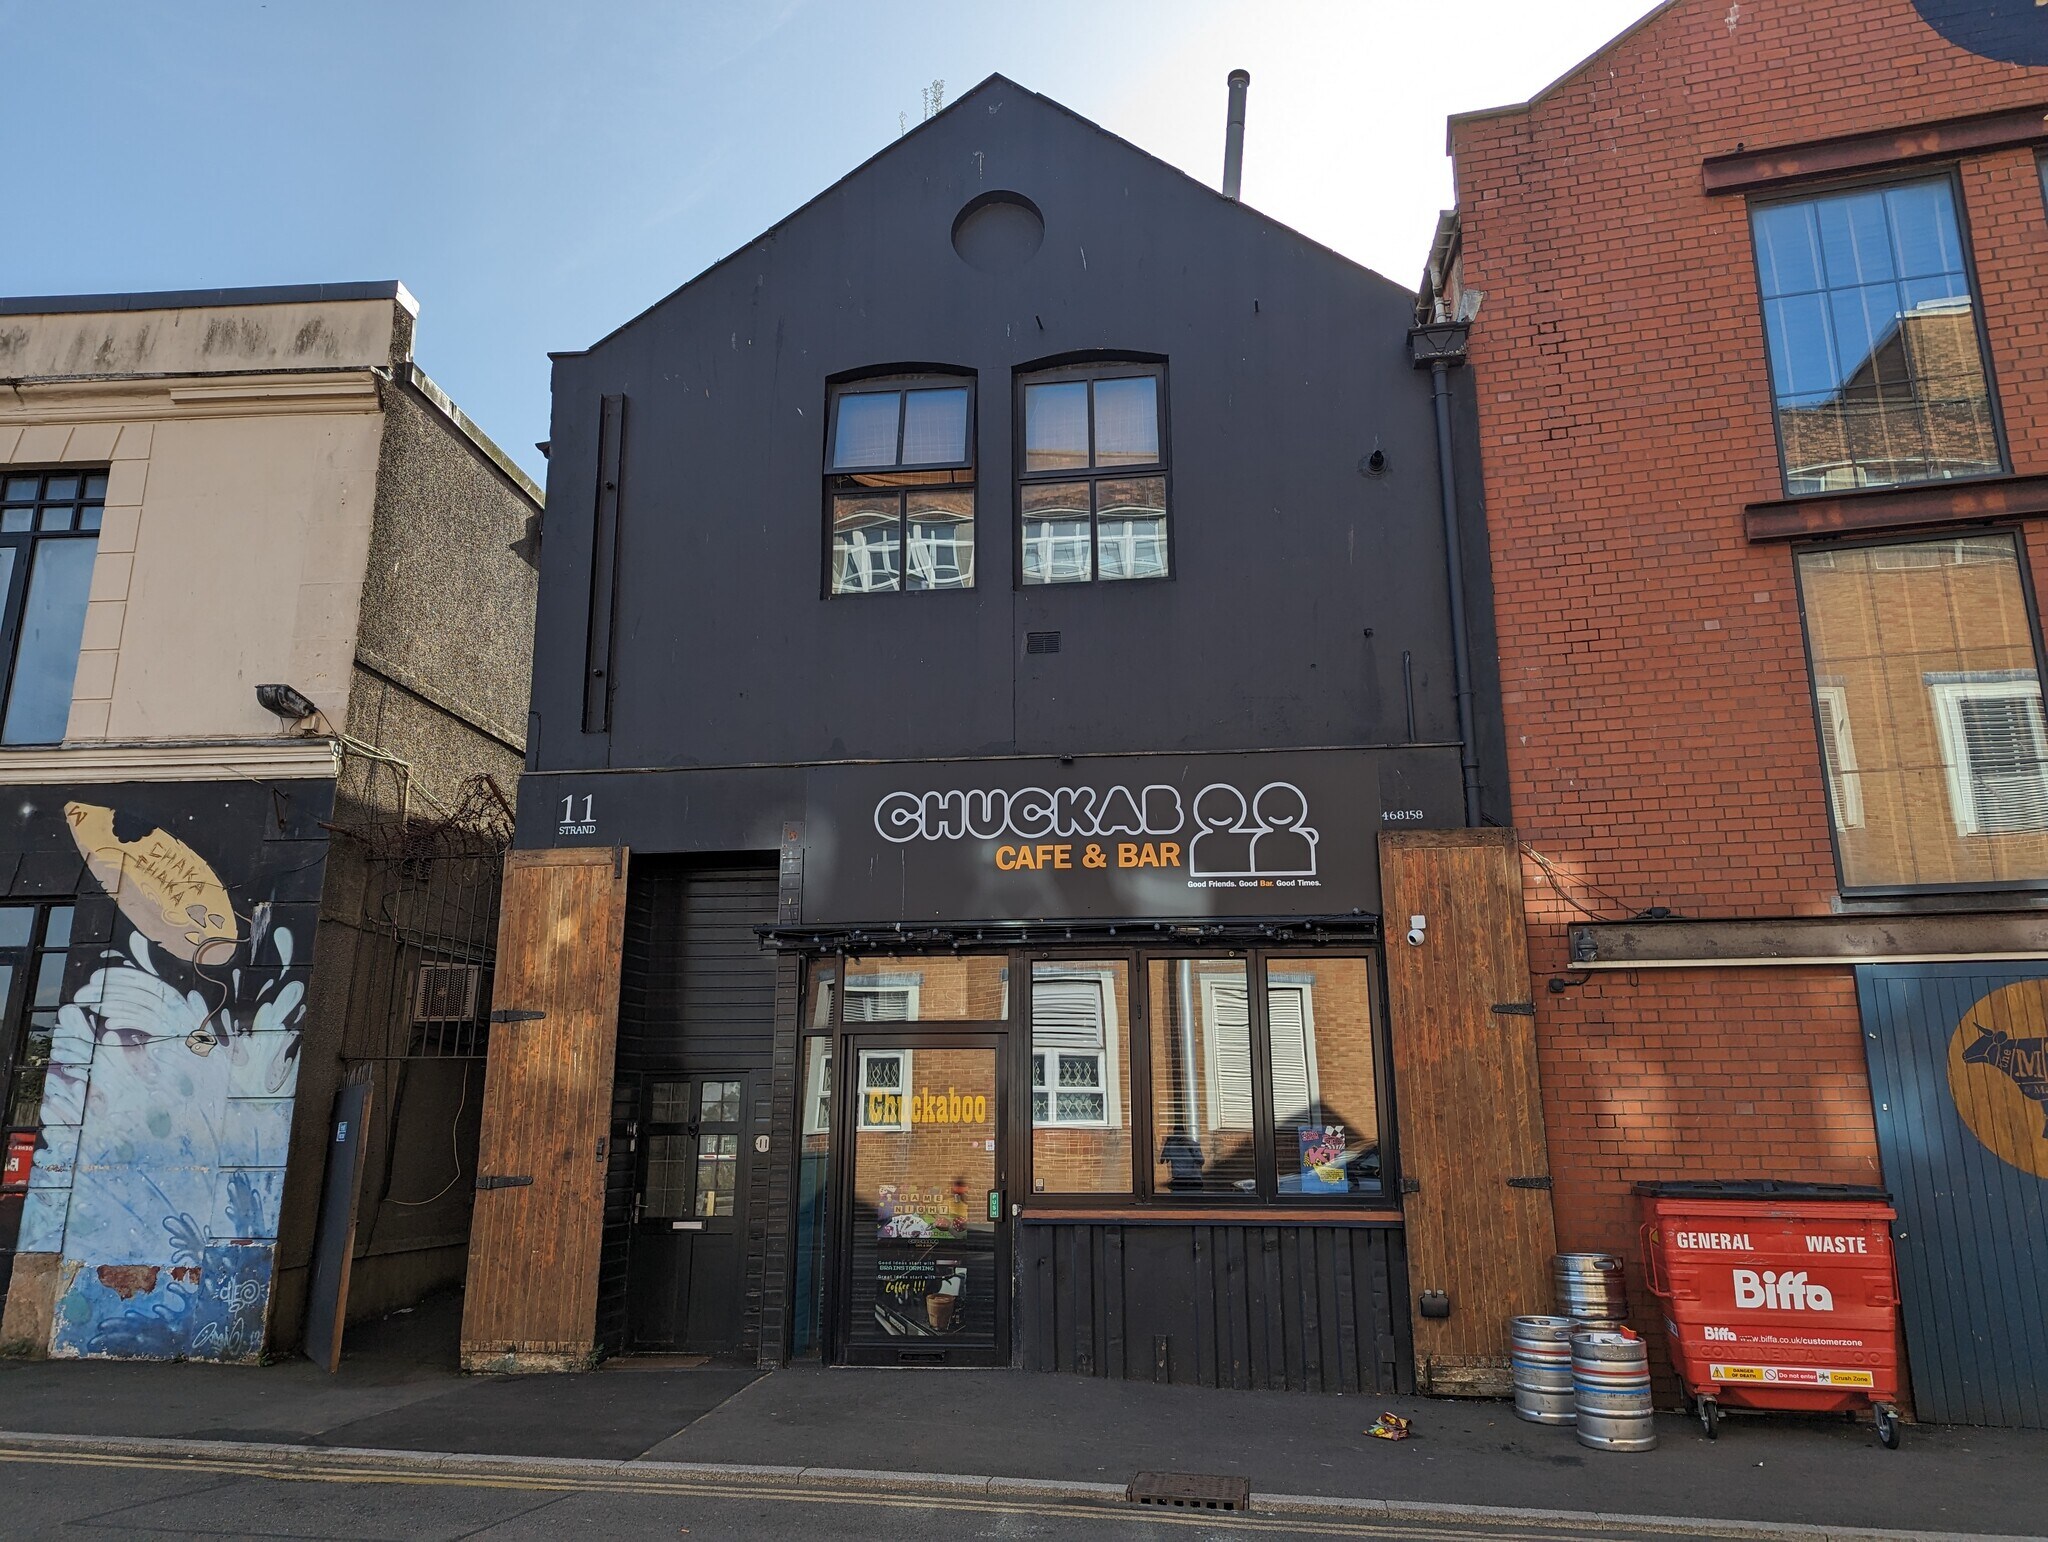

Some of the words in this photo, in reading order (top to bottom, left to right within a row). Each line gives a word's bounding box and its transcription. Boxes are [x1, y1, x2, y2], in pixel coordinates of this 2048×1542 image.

[560, 794, 597, 824] 11
[1382, 810, 1424, 821] 468158
[558, 825, 596, 835] STRAND
[995, 845, 1072, 871] CAFE
[1082, 843, 1107, 869] &
[1118, 842, 1181, 868] BAR
[149, 842, 206, 895] CHAKA
[136, 855, 185, 907] CHAKA
[1187, 880, 1206, 888] Good
[1208, 880, 1237, 888] Friends.
[1276, 879, 1295, 887] Good
[1297, 879, 1321, 887] Times.
[868, 1087, 986, 1124] Chuckaboo
[901, 1194, 942, 1202] GAME
[1677, 1232, 1754, 1251] GENERAL
[1805, 1236, 1867, 1254] WASTE
[885, 1280, 910, 1294] Coffee
[1732, 1269, 1834, 1311] Biffa
[1704, 1326, 1737, 1341] Biffa
